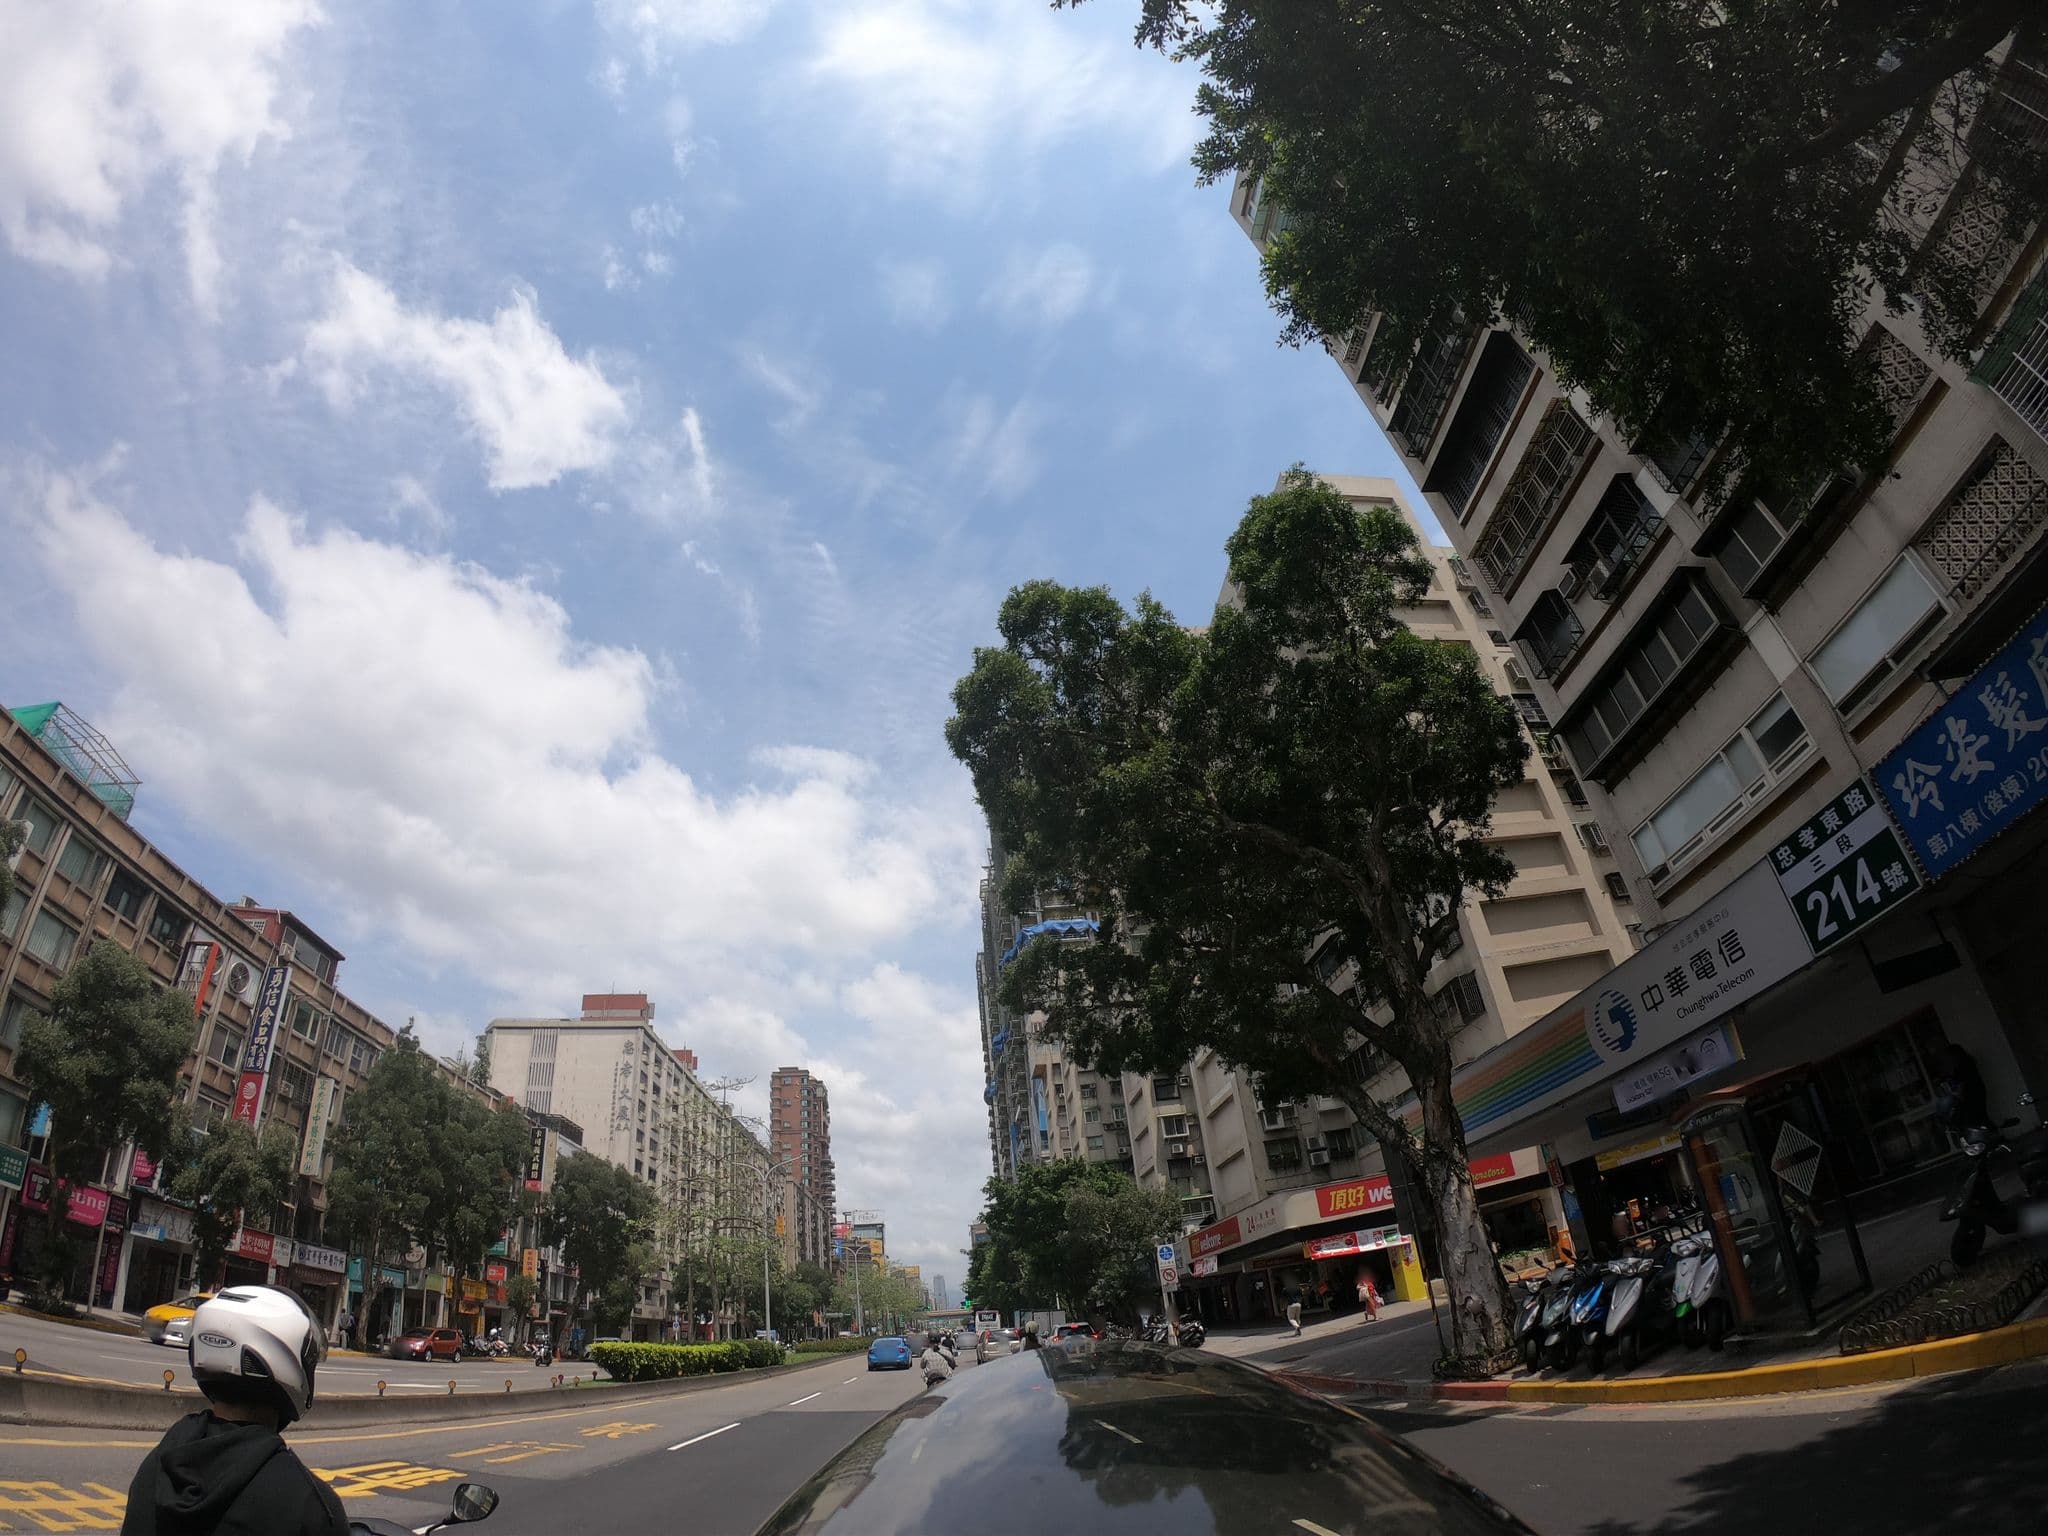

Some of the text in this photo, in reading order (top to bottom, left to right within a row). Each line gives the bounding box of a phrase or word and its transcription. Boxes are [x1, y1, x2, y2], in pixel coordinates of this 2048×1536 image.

[1777, 787, 1869, 869] 忠孝東路
[1809, 834, 1854, 873] 三段
[1806, 857, 1910, 941] 214號
[1640, 929, 1746, 1013] 中華電信
[1676, 967, 1755, 1020] Chunghwa Telecom
[1329, 1185, 1365, 1212] 頂好
